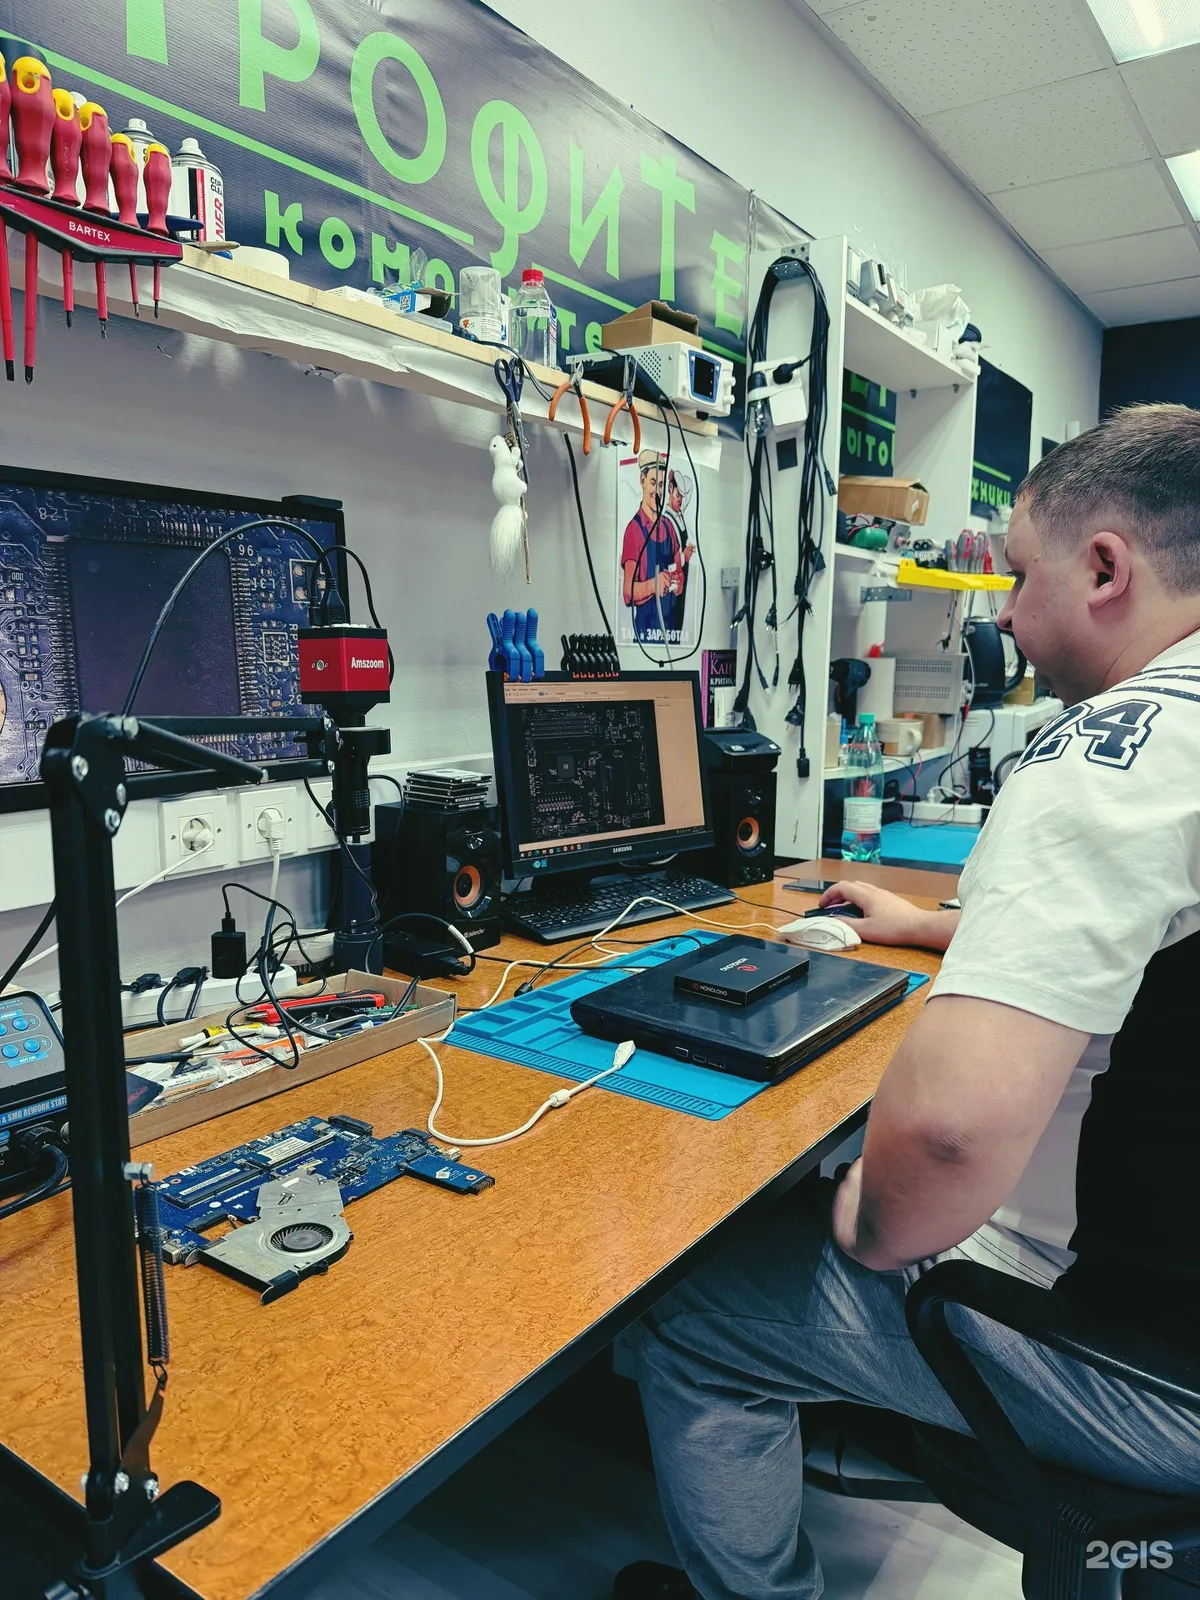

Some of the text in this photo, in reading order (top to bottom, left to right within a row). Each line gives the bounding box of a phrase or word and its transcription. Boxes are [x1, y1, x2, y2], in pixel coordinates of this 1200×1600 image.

[127, 0, 746, 340] РОФИТЕ
[214, 197, 225, 242] NER
[68, 220, 111, 243] BARTEX
[350, 656, 385, 670] Amszoom
[1014, 698, 1163, 771] 24
[612, 845, 633, 854] SAMSUNG
[8, 1110, 23, 1121] SMD
[23, 1101, 50, 1116] REWORK
